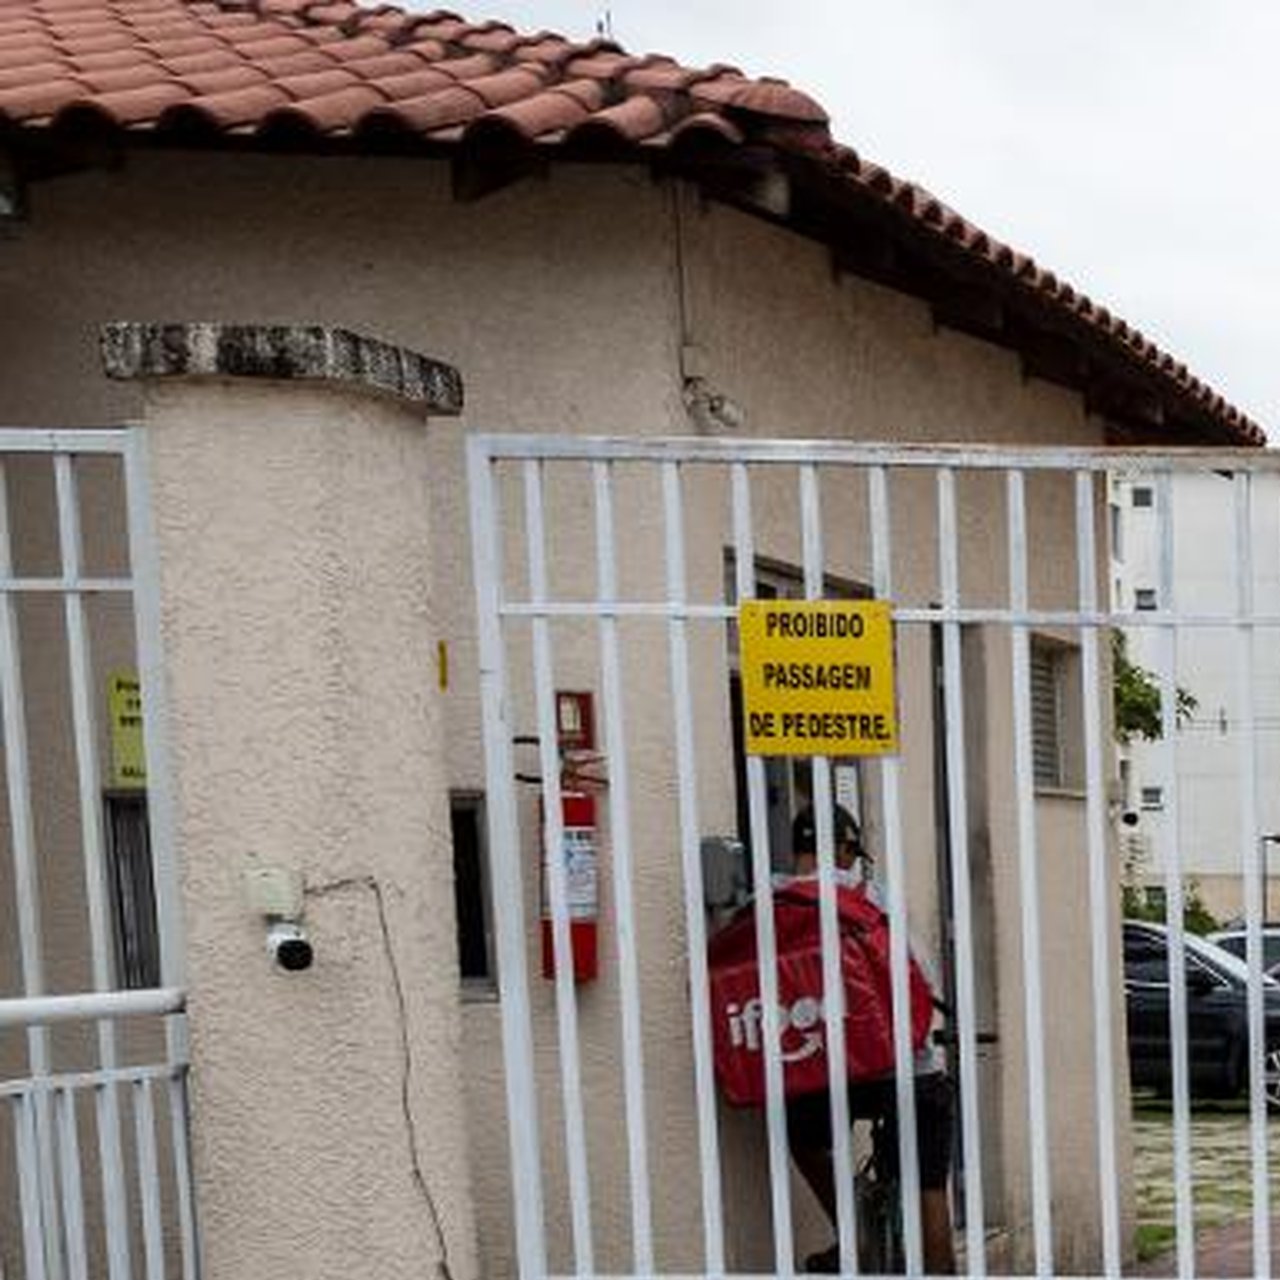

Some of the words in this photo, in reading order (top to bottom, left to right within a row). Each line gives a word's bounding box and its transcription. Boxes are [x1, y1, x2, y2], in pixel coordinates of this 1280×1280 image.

[767, 612, 863, 638] PROIBIDO
[763, 663, 870, 690] PASSAGEM
[749, 712, 776, 737] DE
[782, 713, 890, 740] PEDESTRE.
